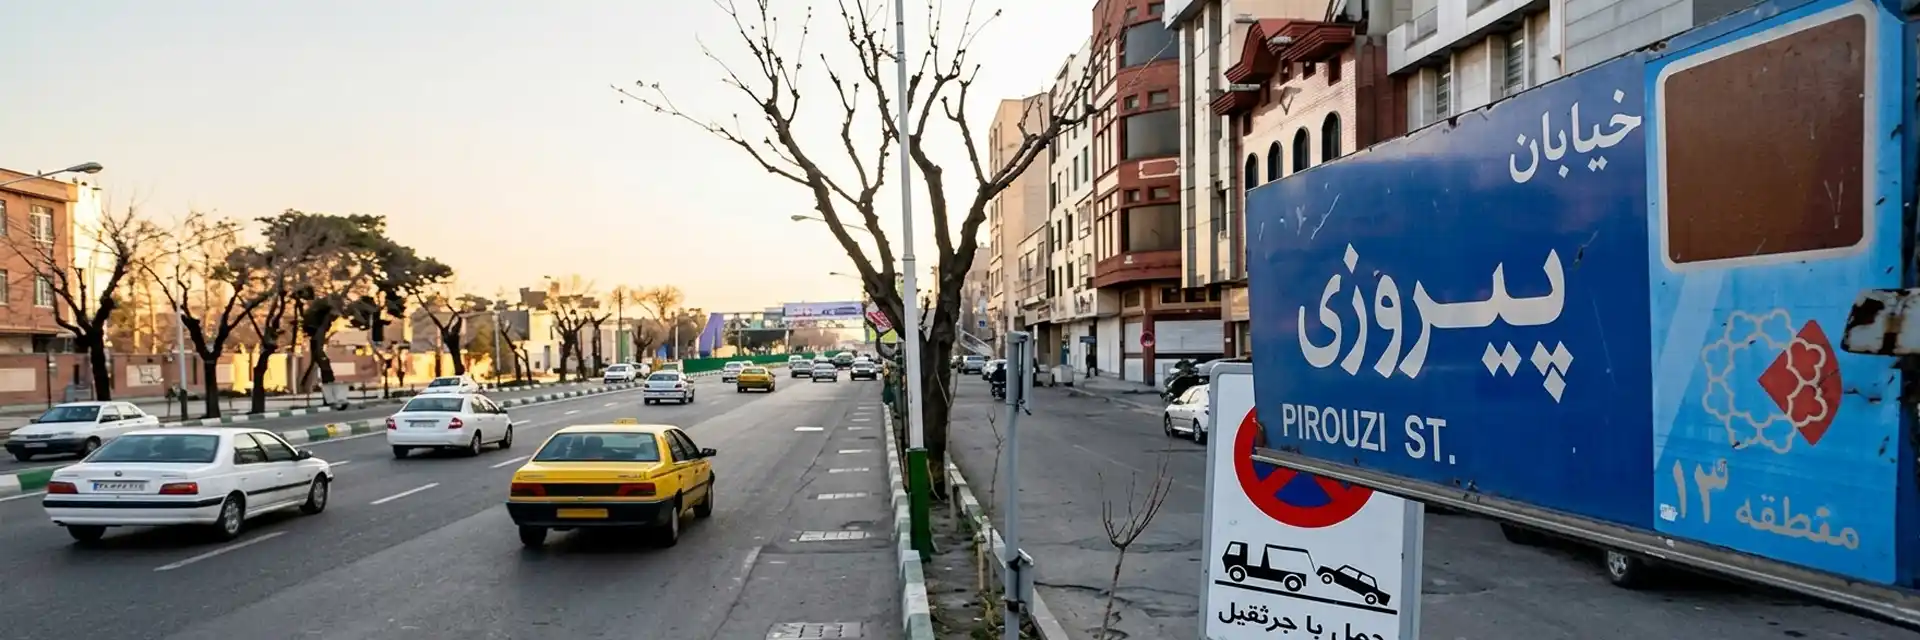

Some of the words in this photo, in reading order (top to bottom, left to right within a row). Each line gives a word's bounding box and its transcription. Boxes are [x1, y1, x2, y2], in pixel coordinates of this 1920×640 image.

[1509, 88, 1643, 184] خیابان
[1297, 242, 1573, 403] پیروزی
[1282, 403, 1387, 452] PIROUZI
[1404, 414, 1457, 465] ST.
[1672, 458, 1729, 523] ۱۳
[1735, 493, 1860, 550] منطقه
[1217, 601, 1298, 635] جرثقیل
[1306, 615, 1324, 640] با
